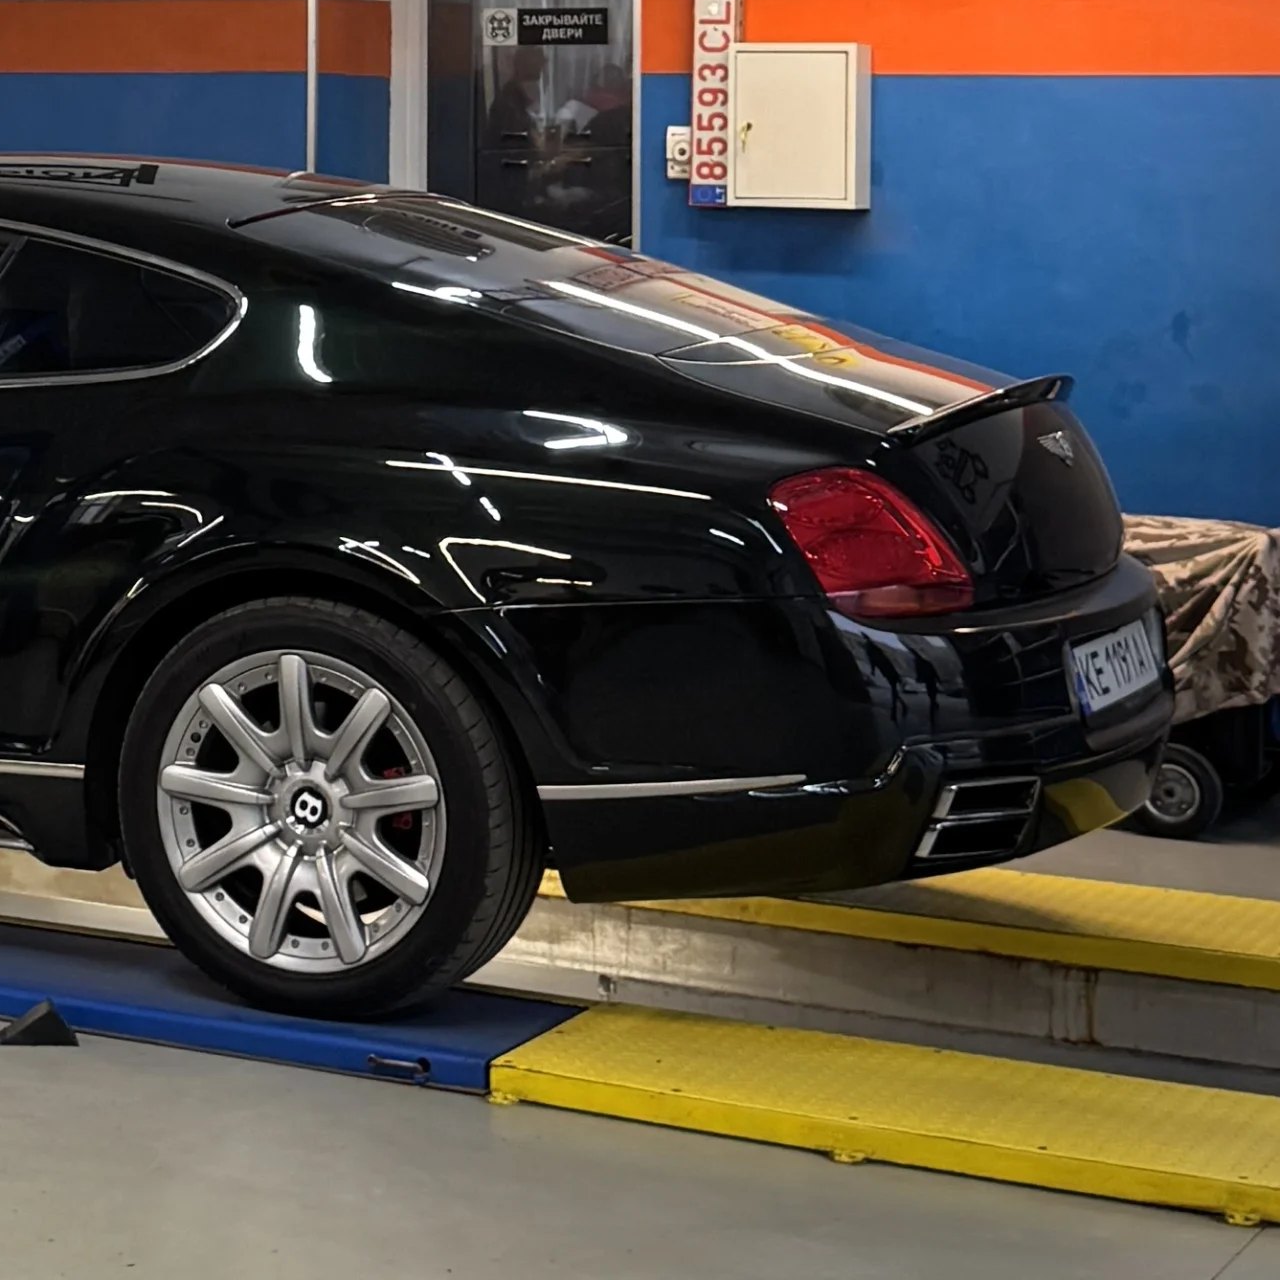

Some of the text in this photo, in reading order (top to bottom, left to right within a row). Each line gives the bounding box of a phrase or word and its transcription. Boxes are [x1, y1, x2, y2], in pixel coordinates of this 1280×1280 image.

[522, 12, 603, 26] ЗАКРЫВАЙТЕ
[542, 28, 583, 40] ДВЕРИ
[698, 0, 731, 53] CL
[695, 62, 730, 181] 85593
